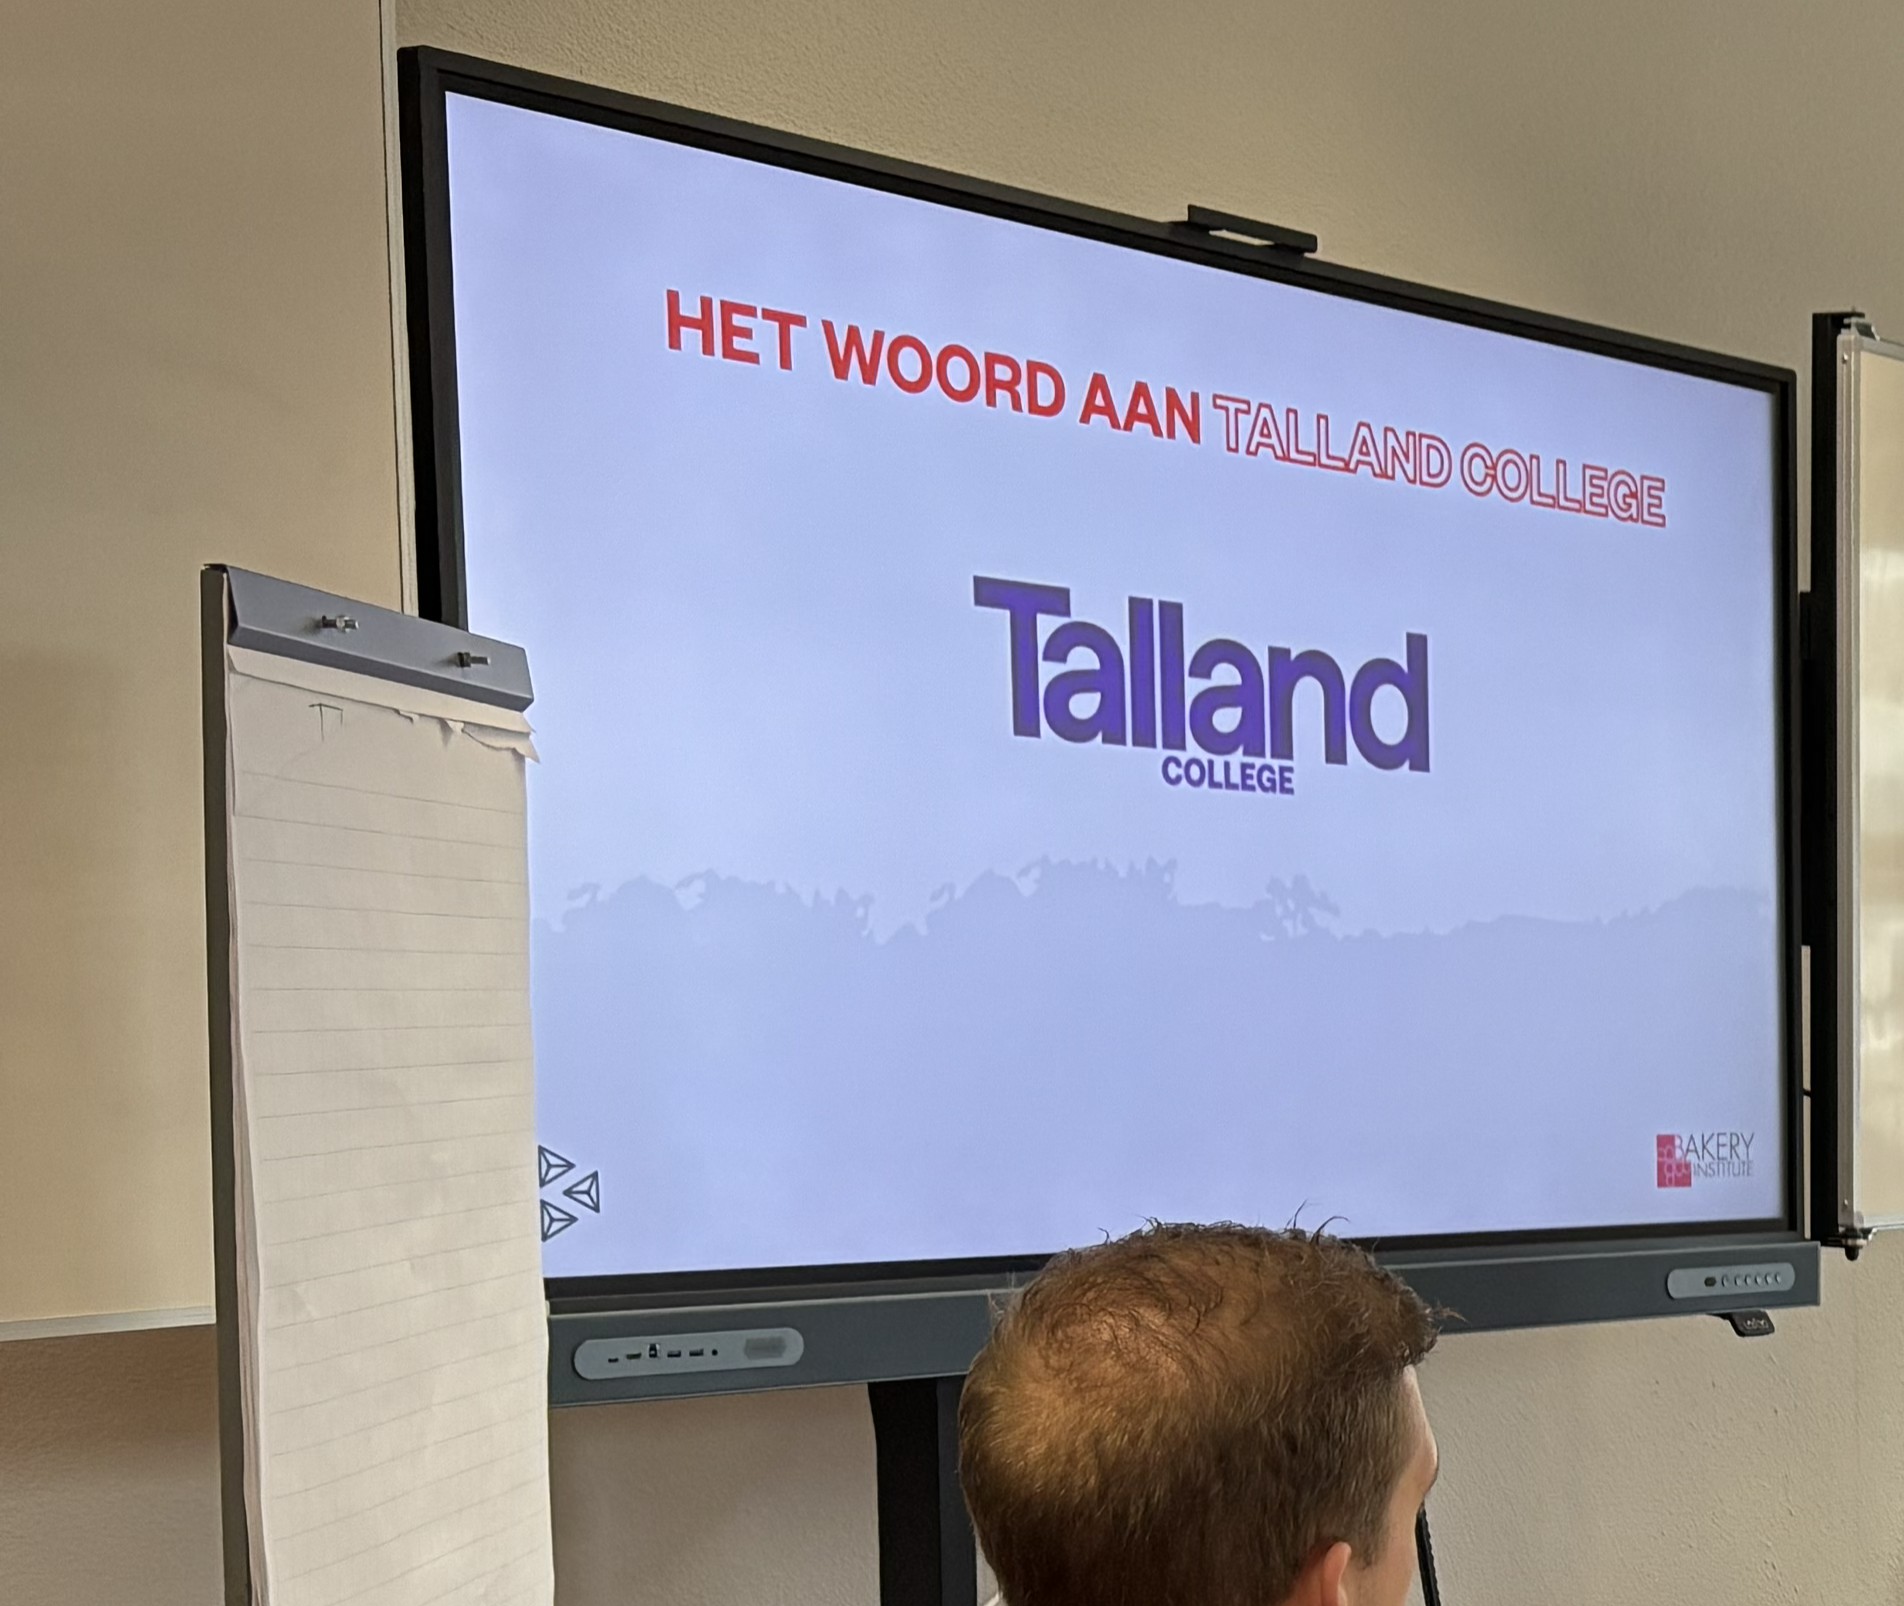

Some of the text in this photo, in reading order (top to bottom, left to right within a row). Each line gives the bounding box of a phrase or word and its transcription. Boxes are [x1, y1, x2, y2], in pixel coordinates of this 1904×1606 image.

[666, 289, 1667, 528] HET WOORD AAN TALLAND COLLEGE
[972, 574, 1431, 773] Talland
[1160, 755, 1295, 796] COLLEGE
[1674, 1131, 1755, 1161] BAKERY
[1692, 1160, 1754, 1178] INSTITUTE
